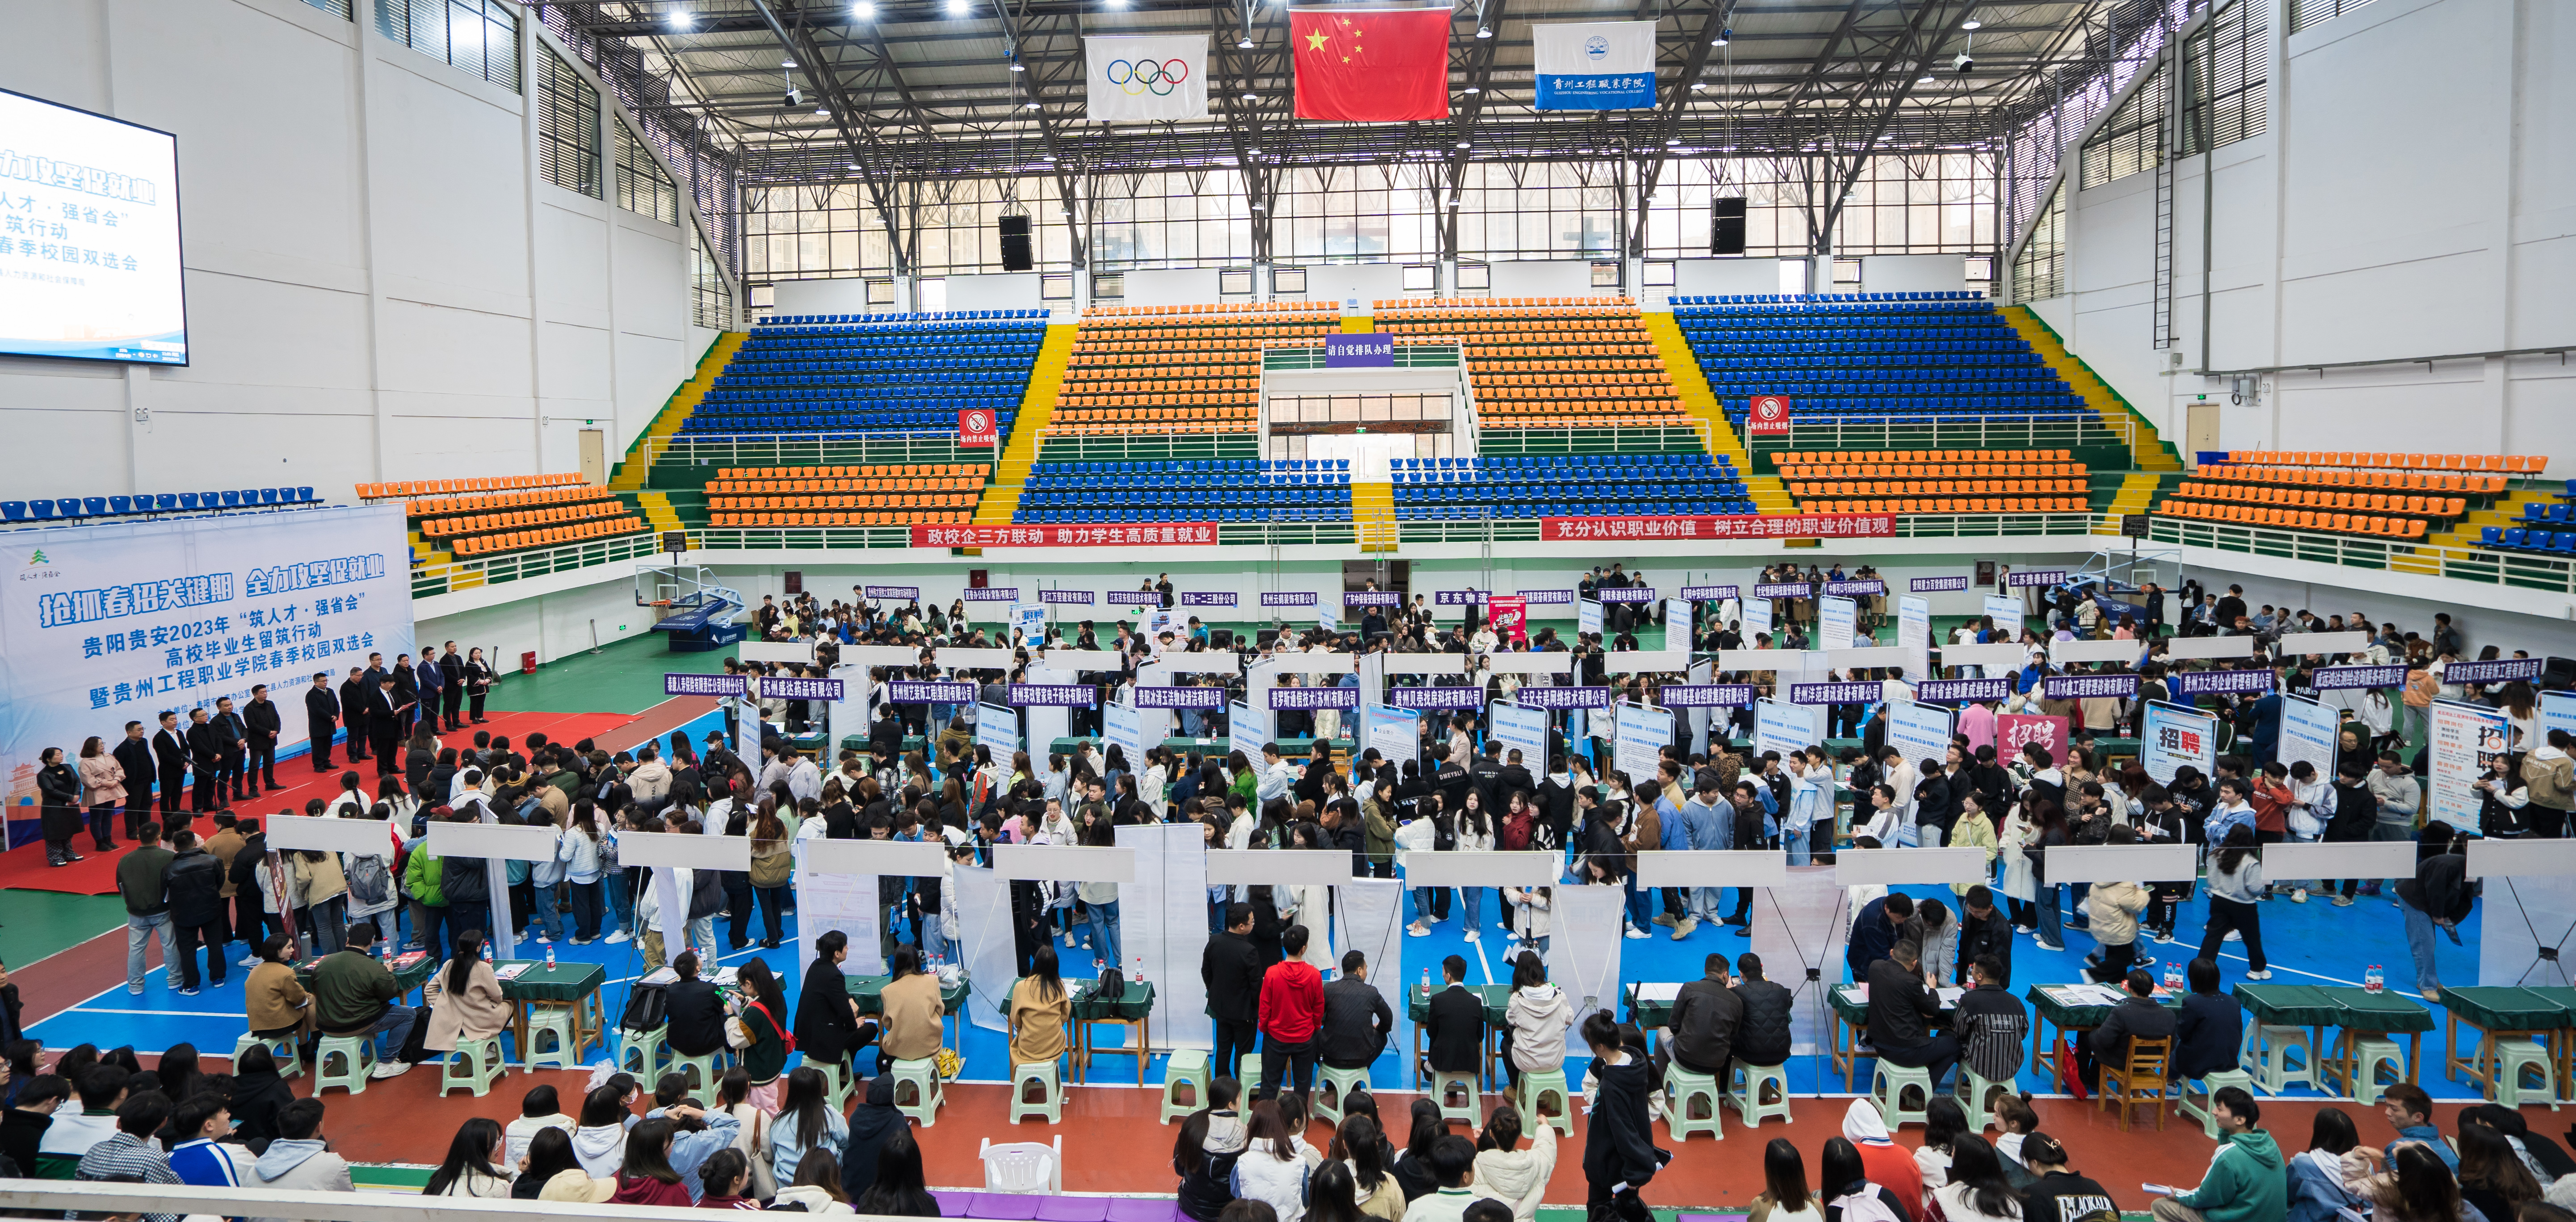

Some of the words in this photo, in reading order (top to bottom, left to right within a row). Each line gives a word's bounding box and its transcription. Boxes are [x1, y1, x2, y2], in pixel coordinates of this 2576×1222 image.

[6, 214, 67, 240] 筑行动
[1328, 344, 1391, 356] 请自觉排队办理
[1751, 421, 1788, 430] 场内禁止吸烟
[960, 434, 996, 443] 场内禁止吸烟
[928, 528, 1043, 544] 政校企三方联动
[1057, 527, 1211, 544] 助力学生高质量就业
[1557, 520, 1696, 537] 充分认识职业价值
[1714, 517, 1889, 535] 树立合理的职业价值观
[2011, 573, 2064, 586] 江苏捷泰新能源
[39, 572, 234, 628] 抢抓春招关键期
[246, 552, 385, 598] 全力攻坚促就业
[1041, 591, 1093, 603] 浙江万坚建设有限公司
[1109, 593, 1161, 604] 江苏京东信息技术有限公司
[1440, 592, 1488, 603] 京东物流
[1600, 590, 1653, 602] 贵阳弗迪电池有限公司
[1756, 585, 1809, 597] 世纪恒通科技股份有限公司
[1184, 594, 1235, 604] 万向一二三股份公司
[1263, 594, 1315, 605] 贵州云鹤装饰有限公司
[1346, 594, 1399, 604] 广东中保保安服务有限公司
[165, 621, 322, 668] 高校毕业生留筑行动
[90, 631, 374, 710] 暨贵州工程职业学院春季校园双选会
[668, 675, 744, 694] 泰康人寿保险有限责任公司贵州分公司
[763, 679, 841, 698] 苏州盛达药品有限公司
[1921, 681, 2007, 700] 贵州省金驰康成绿色食品
[2047, 678, 2135, 696] 四川水鑫工程管理咨询有限公司
[2184, 672, 2272, 692] 贵州力之邦企业管理有限公司
[892, 684, 972, 701] 贵州创艺装饰工程(集团)有限公司
[1138, 689, 1221, 707] 贵阳冰清玉洁物业清洁有限公司
[1272, 690, 1356, 708] 普罗斯通信技术(苏州)有限公司
[1395, 690, 1480, 707] 贵州贝壳找房科技有限公司
[1521, 690, 1606, 707] 卡兄卡弟网络技术有限公司
[1663, 687, 1749, 705] 贵州创盛基业控股集团有限公司
[2007, 718, 2057, 752] 招聘
[2159, 726, 2200, 754] 招聘
